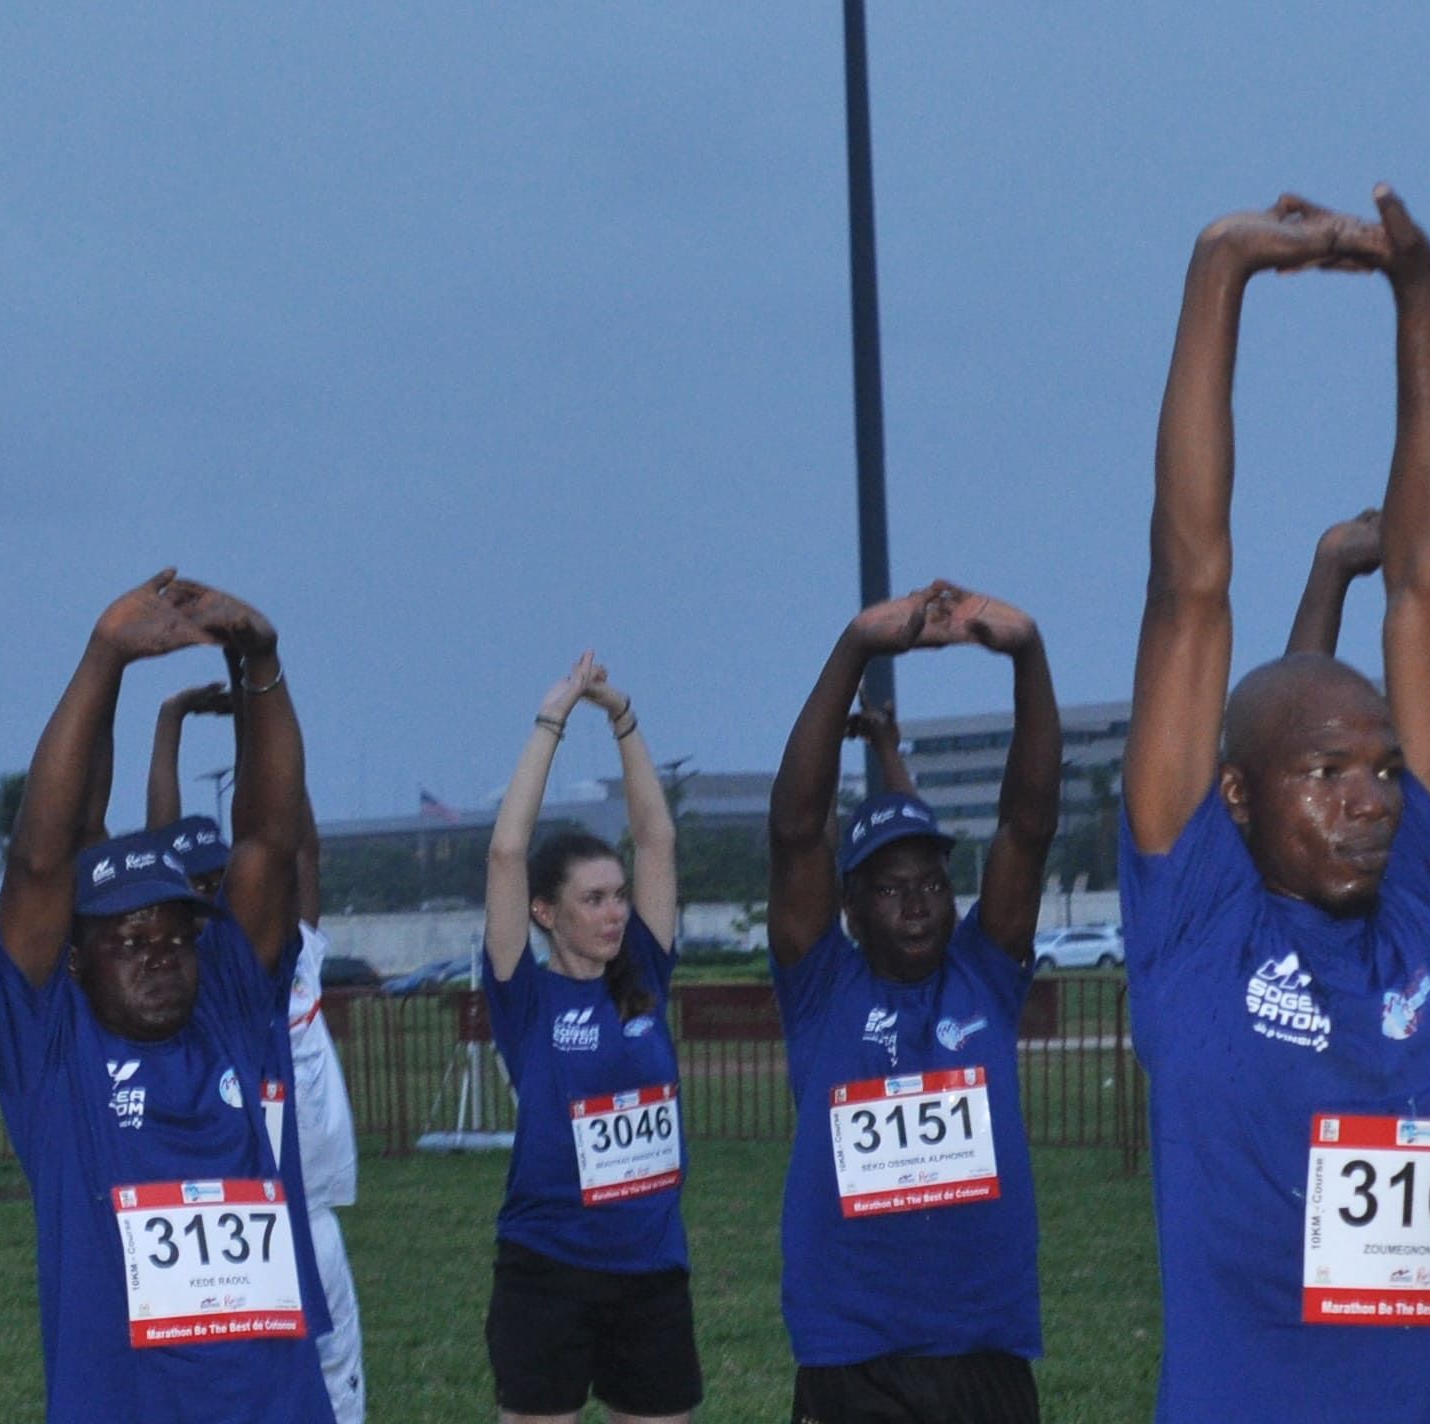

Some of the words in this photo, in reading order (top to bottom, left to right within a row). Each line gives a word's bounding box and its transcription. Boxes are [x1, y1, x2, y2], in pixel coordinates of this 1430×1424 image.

[1248, 978, 1319, 1014] SOGE
[1246, 994, 1331, 1034] SATOM
[589, 1105, 672, 1153] 3046
[851, 1096, 973, 1154] 3151
[854, 1200, 891, 1212] Marathon
[893, 1195, 904, 1206] Be
[906, 1194, 922, 1205] The
[923, 1192, 942, 1203] Best
[944, 1190, 953, 1200] de
[144, 1212, 277, 1269] 3137
[1311, 1215, 1321, 1250] 10KM
[130, 1264, 140, 1291] 10KM
[1321, 1300, 1376, 1314] Marathon
[1378, 1301, 1393, 1315] Be
[1396, 1301, 1414, 1315] The
[146, 1326, 193, 1340] Marathon
[194, 1324, 207, 1336] Be
[209, 1322, 227, 1334] The
[229, 1321, 251, 1333] Best
[252, 1320, 263, 1331] de
